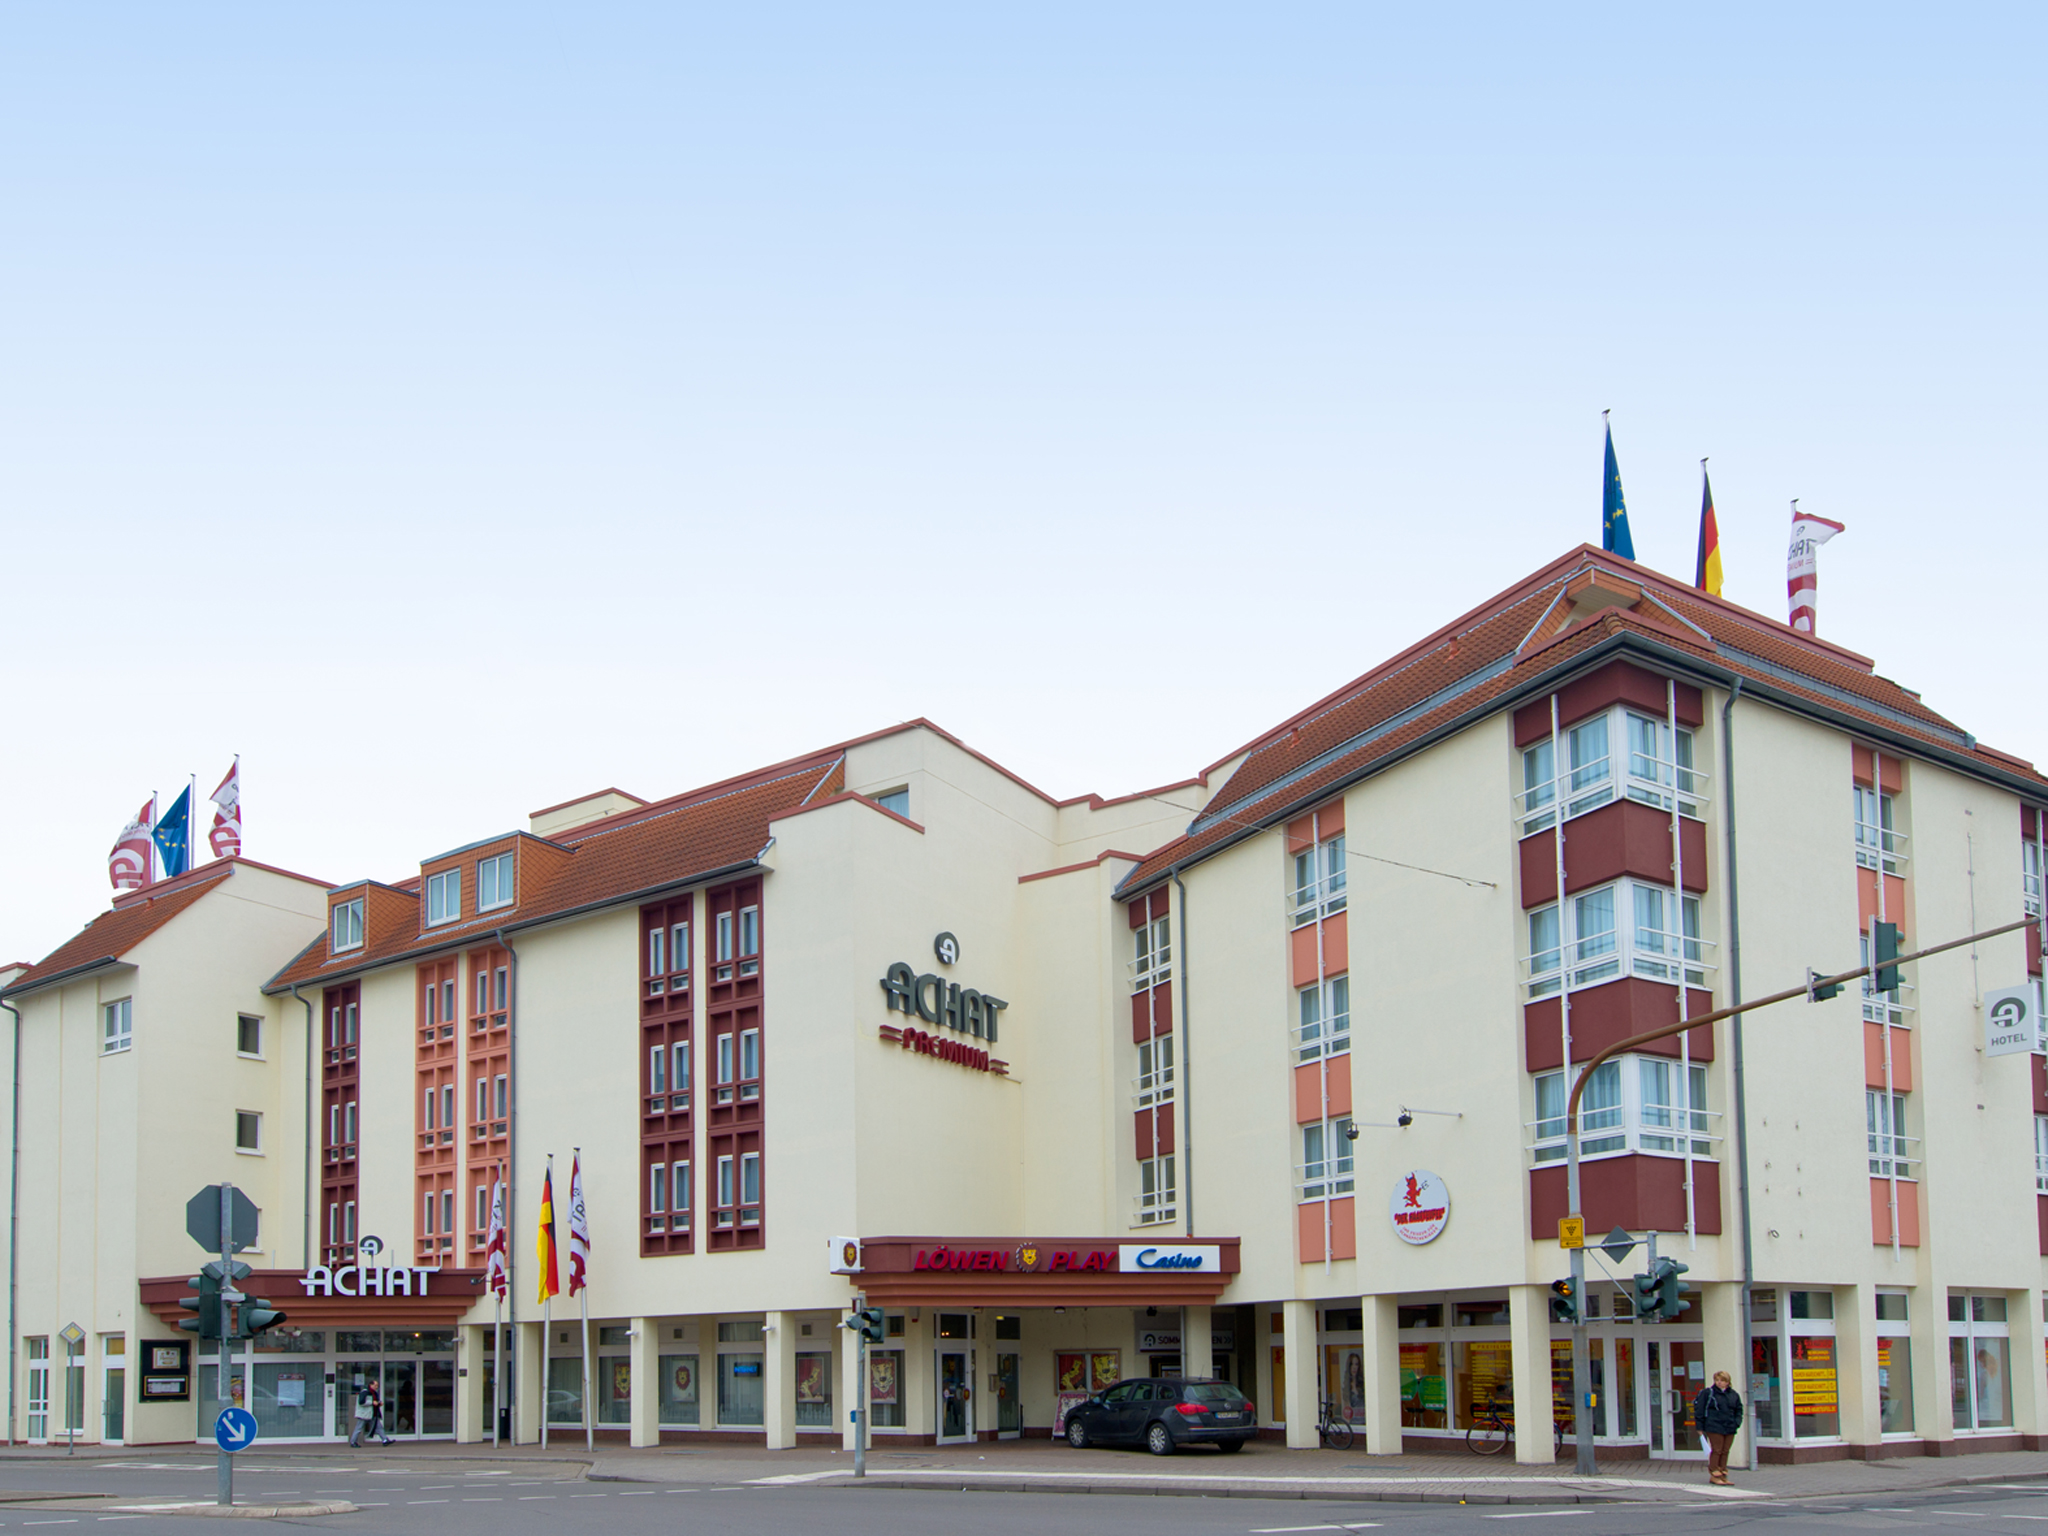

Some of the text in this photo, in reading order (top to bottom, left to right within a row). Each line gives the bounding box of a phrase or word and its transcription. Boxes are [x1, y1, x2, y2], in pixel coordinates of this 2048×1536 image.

[880, 961, 1009, 1043] ACHAT
[902, 1027, 989, 1072] PREMIUM
[1991, 1033, 2027, 1046] HOTEL
[914, 1245, 1117, 1270] LÖWEN PLAY
[1136, 1248, 1202, 1269] Casino
[299, 1265, 440, 1296] ACHAT
